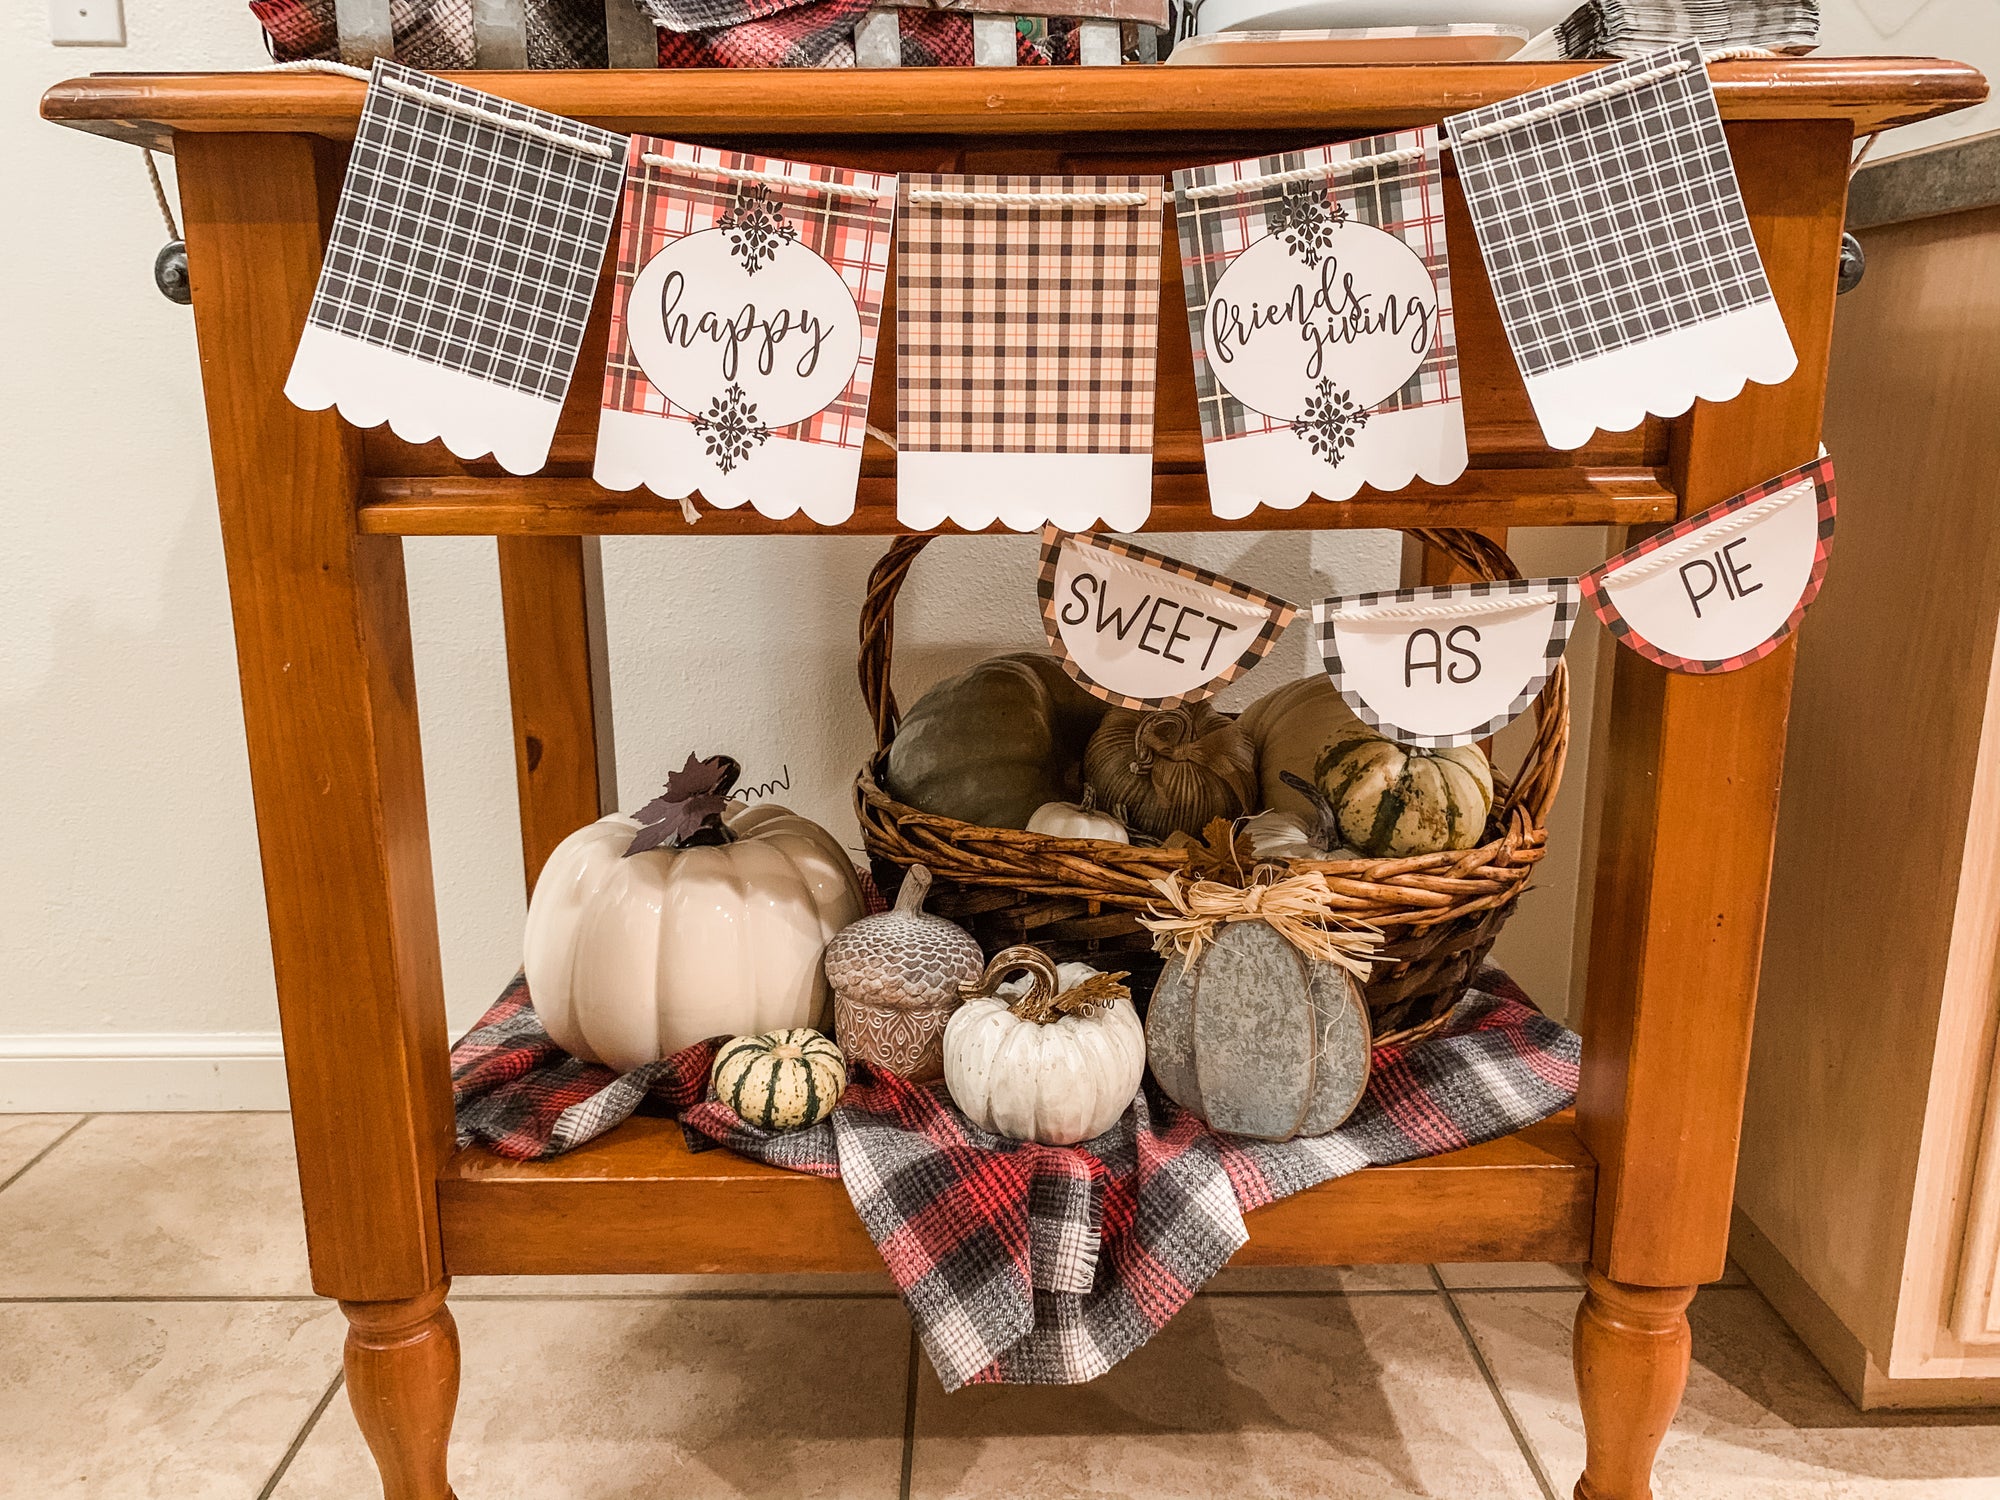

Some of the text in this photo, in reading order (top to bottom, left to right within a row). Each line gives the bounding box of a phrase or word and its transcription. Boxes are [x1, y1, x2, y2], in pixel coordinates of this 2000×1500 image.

[661, 270, 834, 382] happy
[1212, 256, 1372, 363] friends
[1301, 294, 1436, 379] giving
[1061, 537, 1763, 688] SWEET AS PIE
